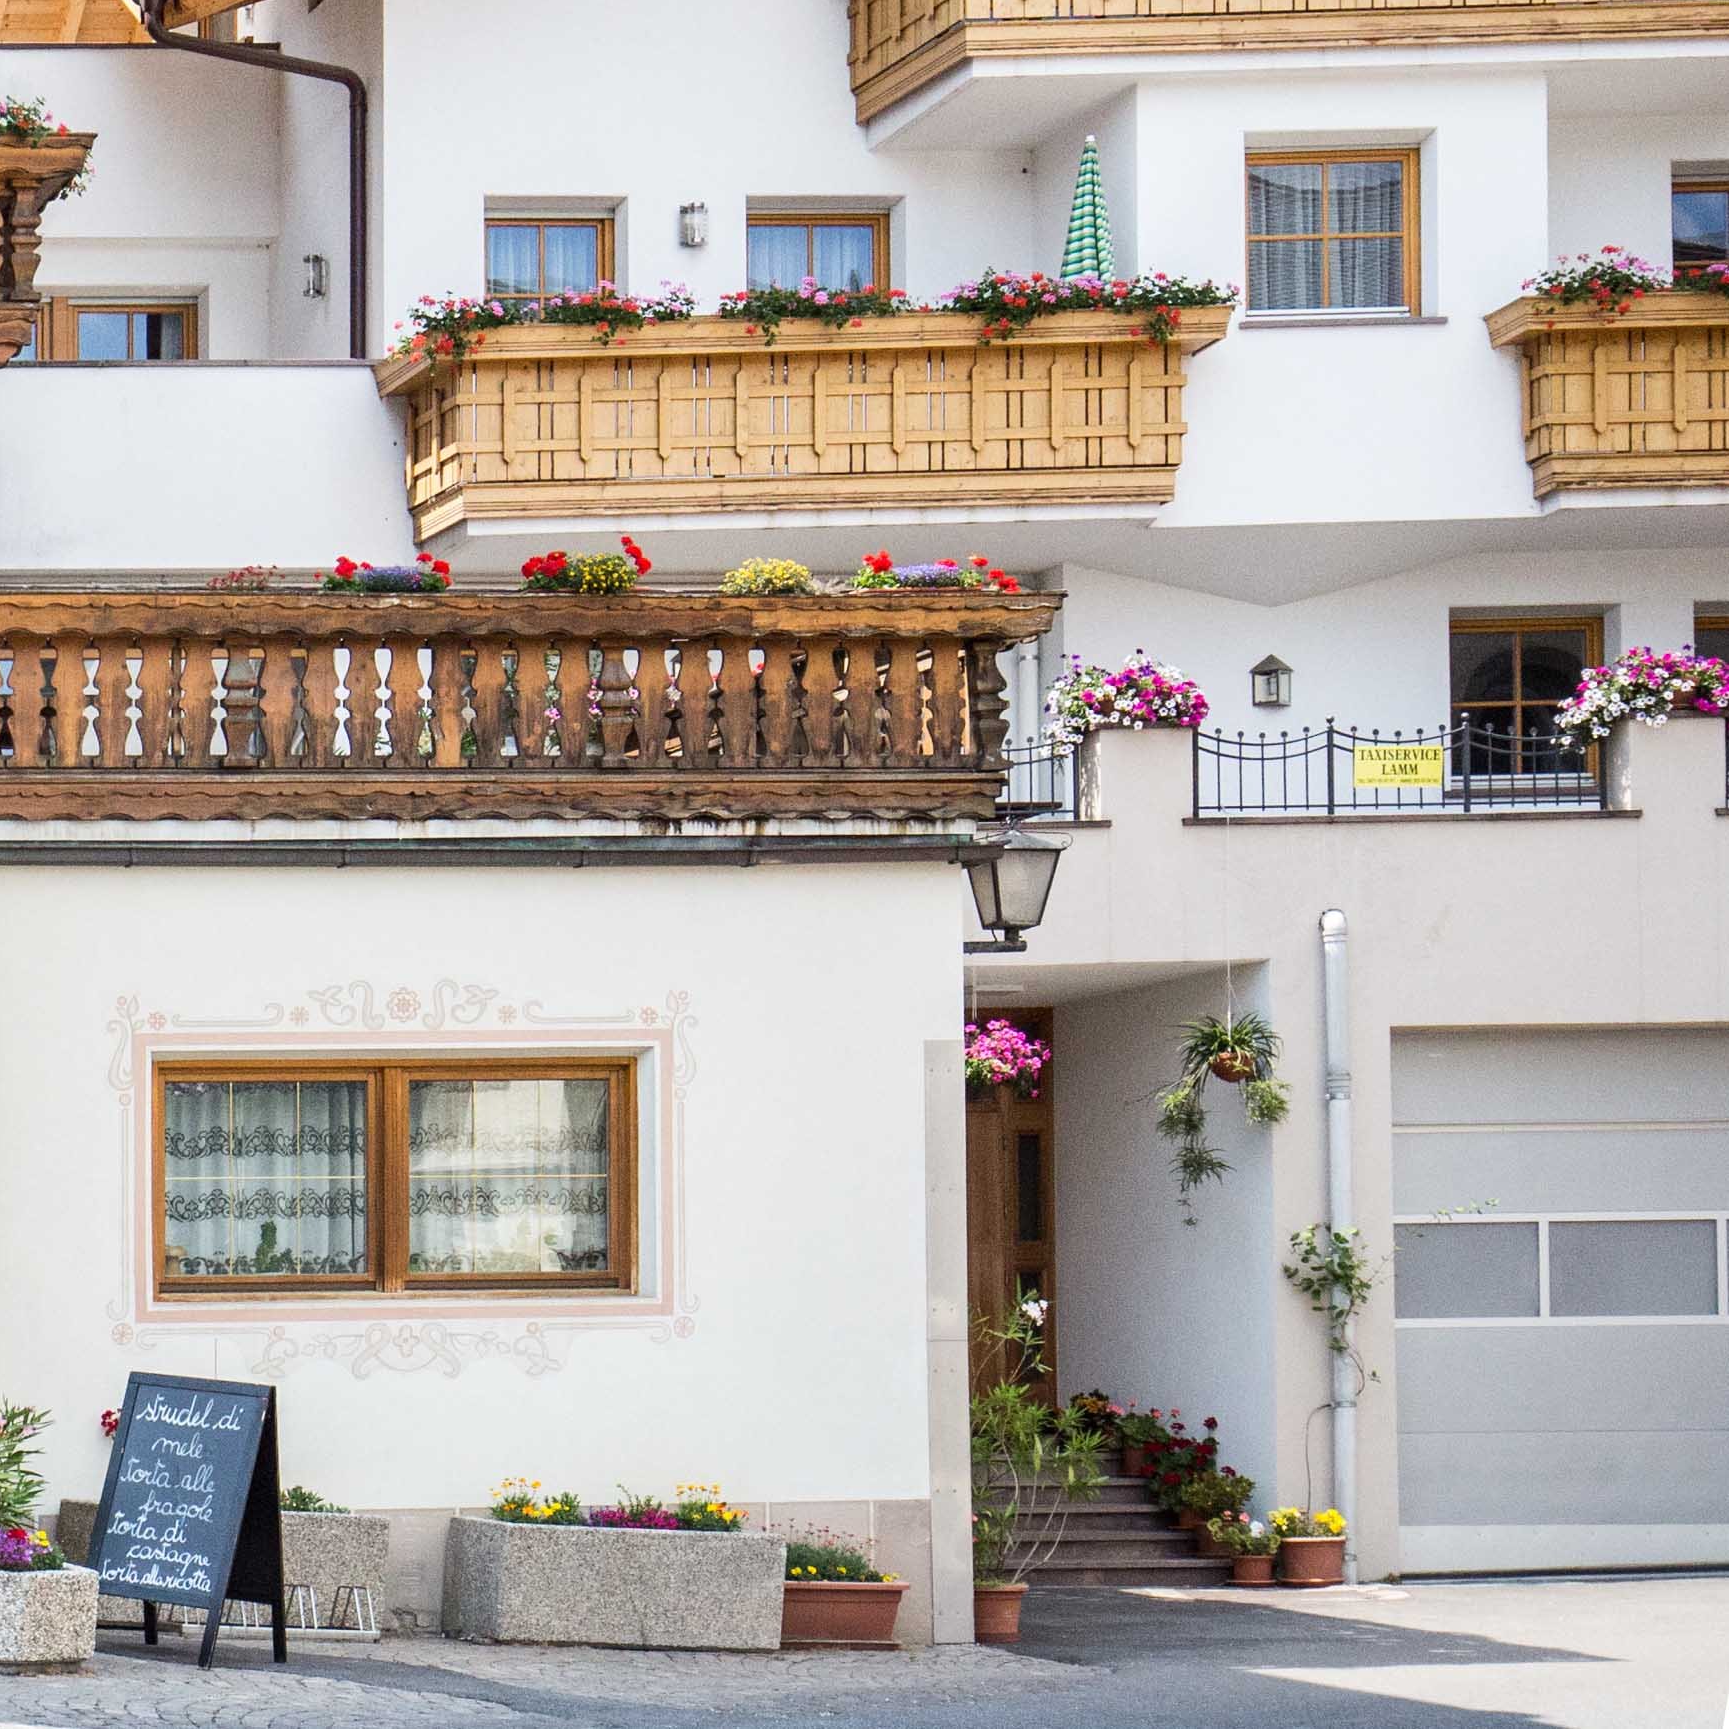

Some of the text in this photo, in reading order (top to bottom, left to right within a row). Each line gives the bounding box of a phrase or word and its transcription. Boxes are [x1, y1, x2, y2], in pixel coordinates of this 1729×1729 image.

[1359, 749, 1441, 761] TAXISERVICE
[1382, 763, 1419, 775] LAMM
[136, 1394, 243, 1430] strudel di
[151, 1432, 203, 1458] mele
[121, 1456, 215, 1492] torta alle
[139, 1489, 213, 1523] fragole
[107, 1511, 187, 1543] torta di
[98, 1558, 139, 1584] torta
[126, 1542, 211, 1576] castagne
